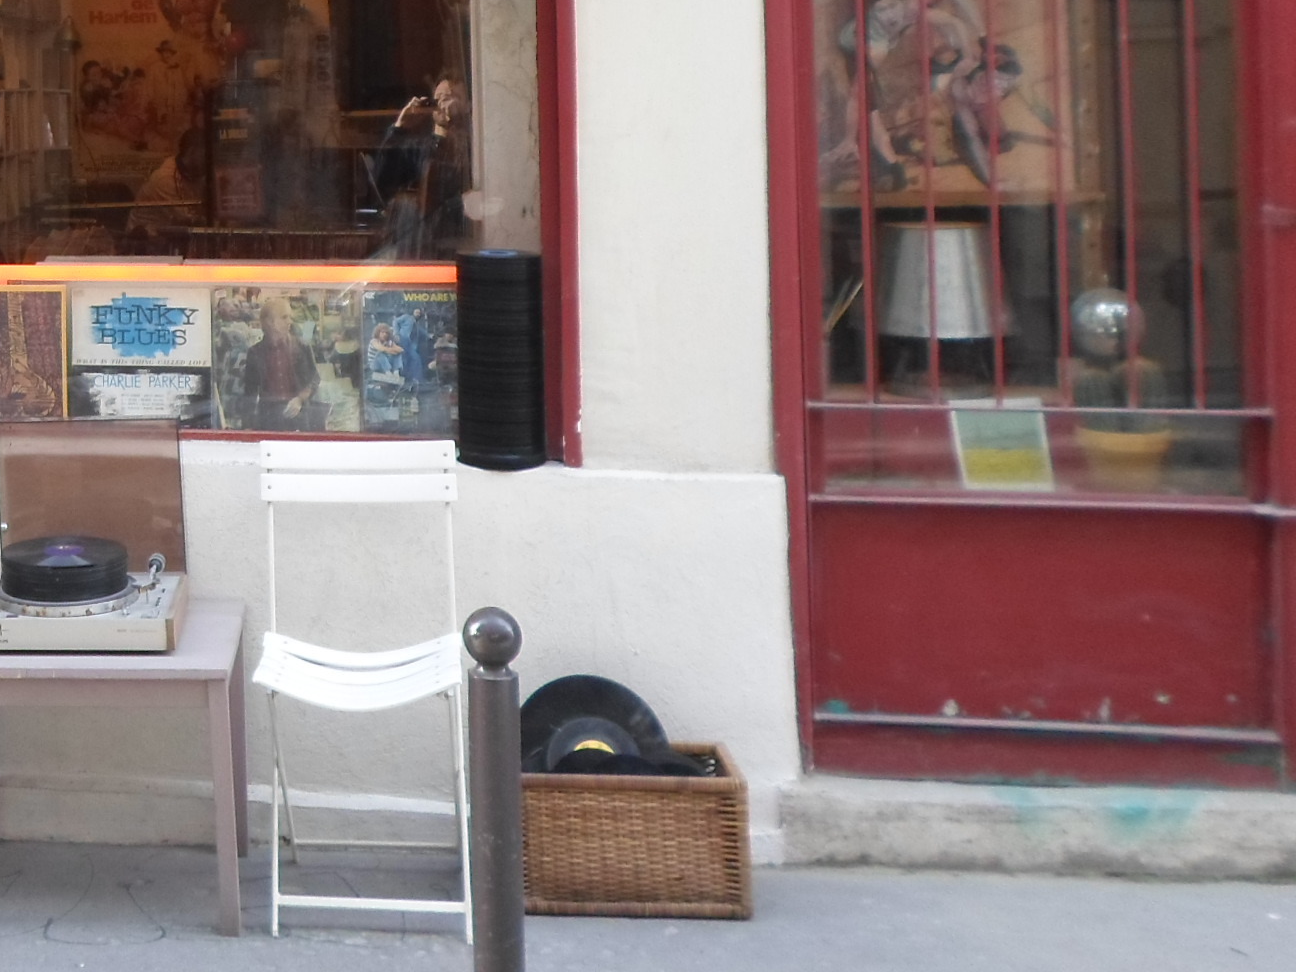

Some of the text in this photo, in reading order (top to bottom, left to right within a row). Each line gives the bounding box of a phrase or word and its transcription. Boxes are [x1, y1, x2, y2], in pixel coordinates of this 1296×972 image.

[89, 11, 157, 25] Harlem
[404, 293, 429, 301] WHO
[431, 293, 449, 301] ARE
[89, 304, 199, 326] FUNKY
[97, 328, 187, 345] BLUES
[93, 375, 192, 390] CHARLIE PARKER
